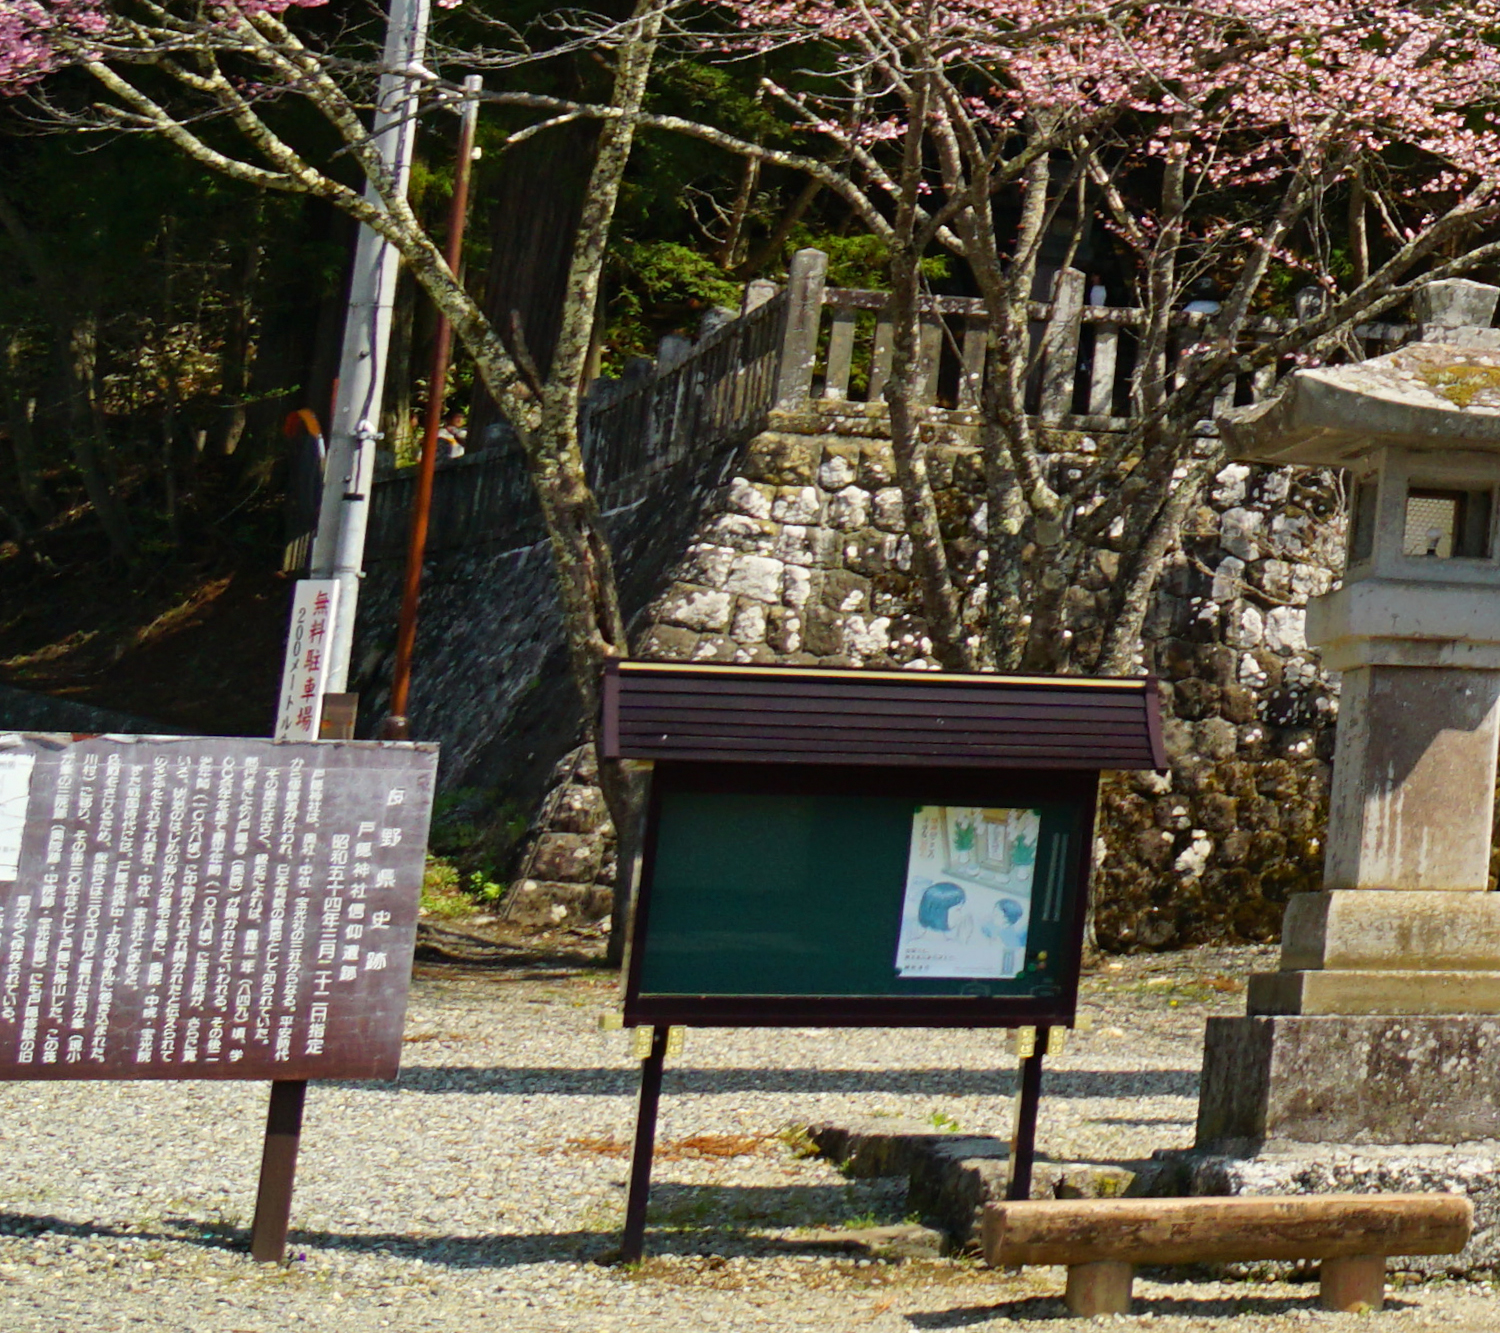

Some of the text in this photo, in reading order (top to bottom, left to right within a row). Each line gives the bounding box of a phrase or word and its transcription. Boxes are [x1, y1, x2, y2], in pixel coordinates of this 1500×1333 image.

[278, 607, 307, 739] 200メートル
[294, 590, 330, 732] 無料駐車場
